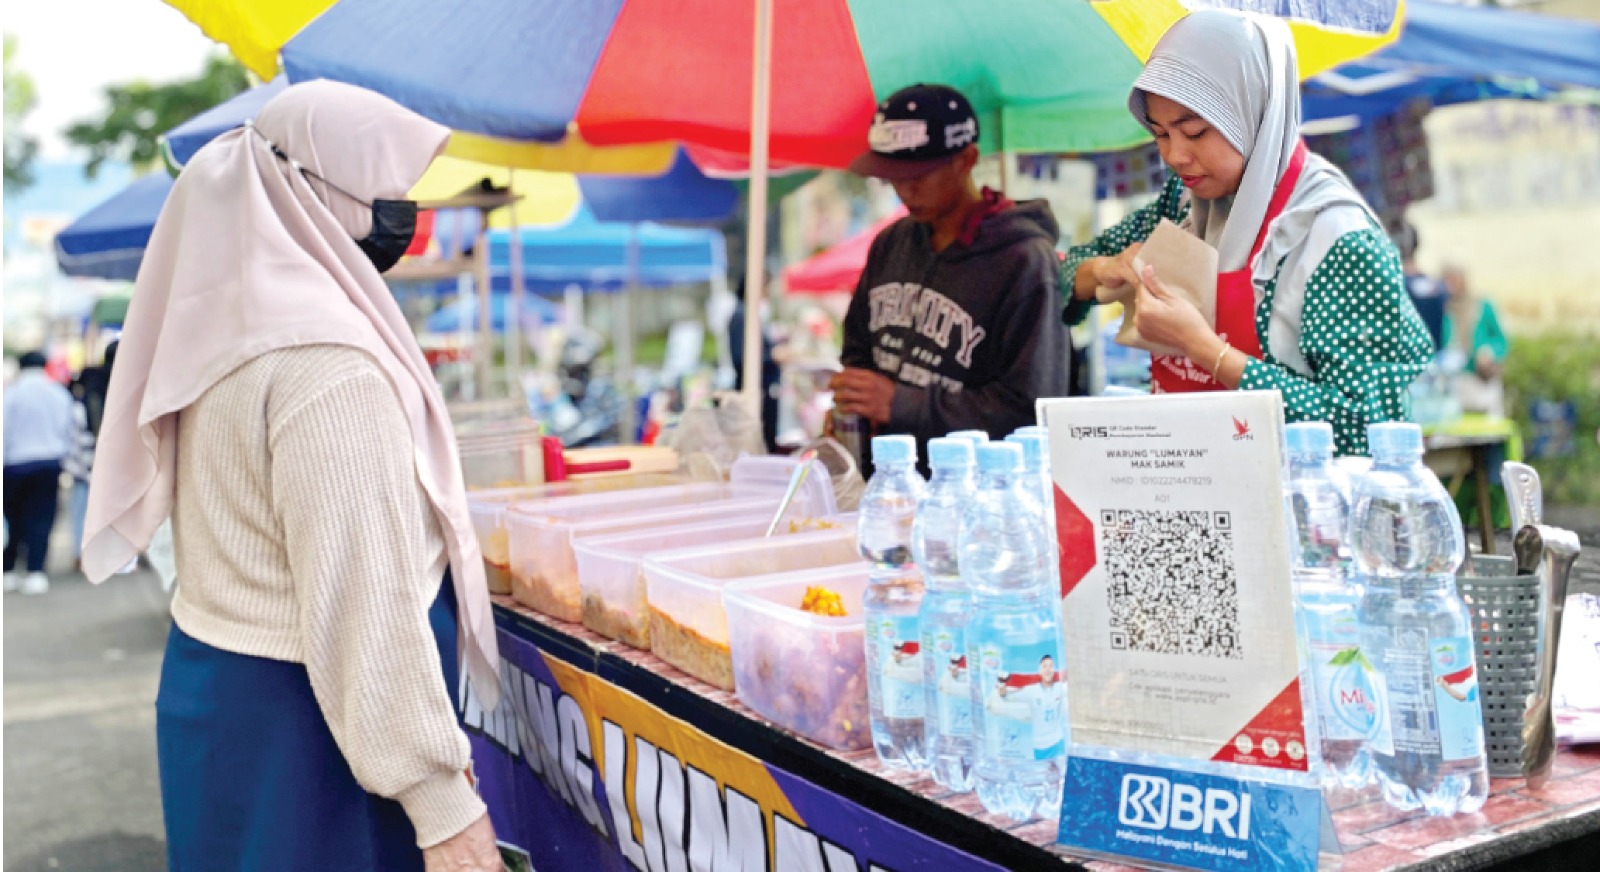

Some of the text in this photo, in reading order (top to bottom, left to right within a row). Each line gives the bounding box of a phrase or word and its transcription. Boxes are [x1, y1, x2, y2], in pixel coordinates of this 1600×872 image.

[1070, 425, 1108, 440] QRIS
[1106, 449, 1208, 458] WARUNG "LUMAYAN"
[1130, 460, 1185, 468] MAK SAMIK
[1169, 783, 1251, 840] BRI
[1115, 829, 1155, 843] Melayani
[1156, 834, 1192, 850] Dengan
[1227, 846, 1248, 859] Hati
